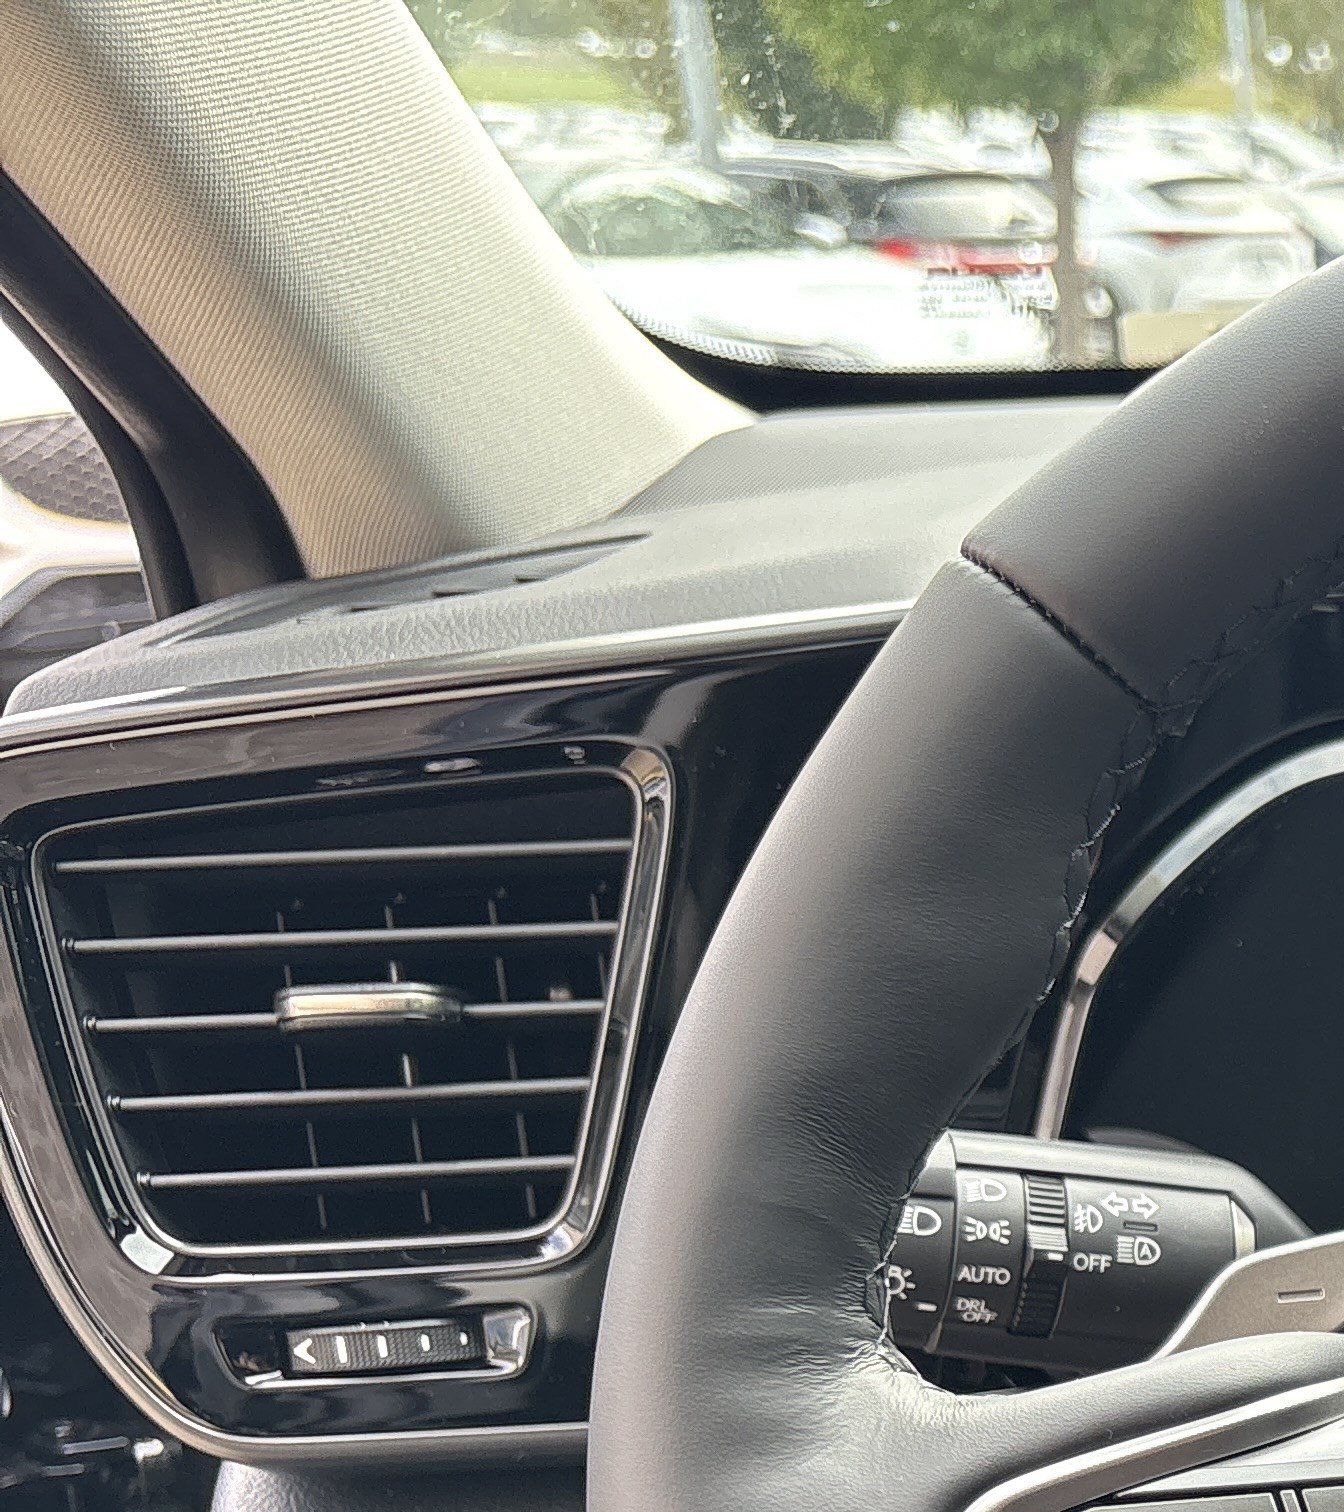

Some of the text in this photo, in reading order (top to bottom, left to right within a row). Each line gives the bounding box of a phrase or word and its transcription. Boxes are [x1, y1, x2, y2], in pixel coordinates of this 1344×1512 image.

[1073, 1253, 1114, 1273] OFF
[957, 1266, 1012, 1286] AUTO
[956, 1296, 986, 1313] DRL
